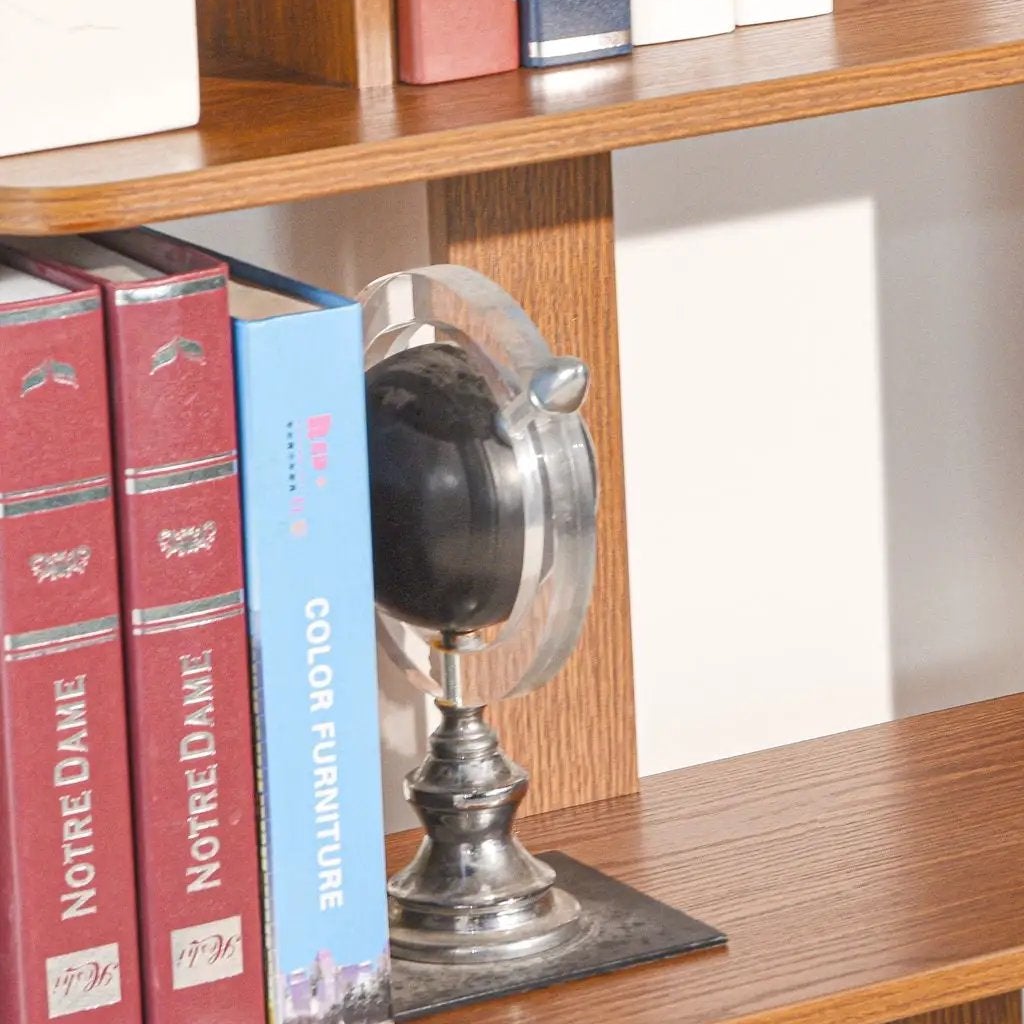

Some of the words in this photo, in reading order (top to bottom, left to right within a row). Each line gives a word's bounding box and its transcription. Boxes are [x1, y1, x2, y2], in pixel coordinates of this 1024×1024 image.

[179, 648, 217, 762] DAME
[304, 597, 334, 713] COLOR
[53, 673, 91, 787] DAME
[60, 789, 97, 921] NOTRE
[185, 763, 222, 893] NOTRE
[312, 721, 344, 912] FURNITURE
